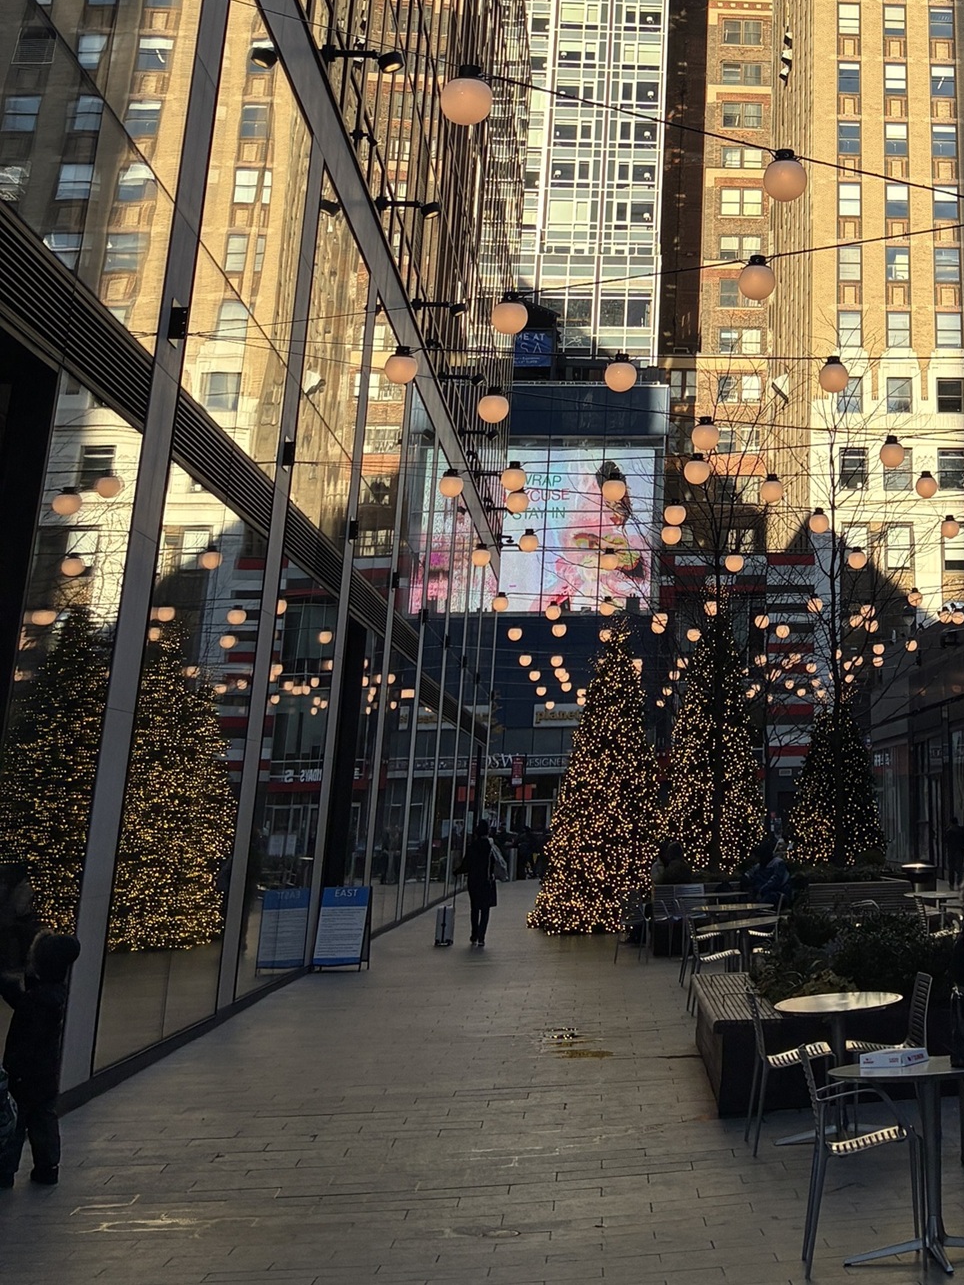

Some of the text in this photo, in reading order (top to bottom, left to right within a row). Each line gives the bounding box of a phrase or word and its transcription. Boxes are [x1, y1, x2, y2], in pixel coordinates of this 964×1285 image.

[532, 332, 545, 341] AT
[551, 506, 566, 519] IN
[334, 888, 359, 898] EAST
